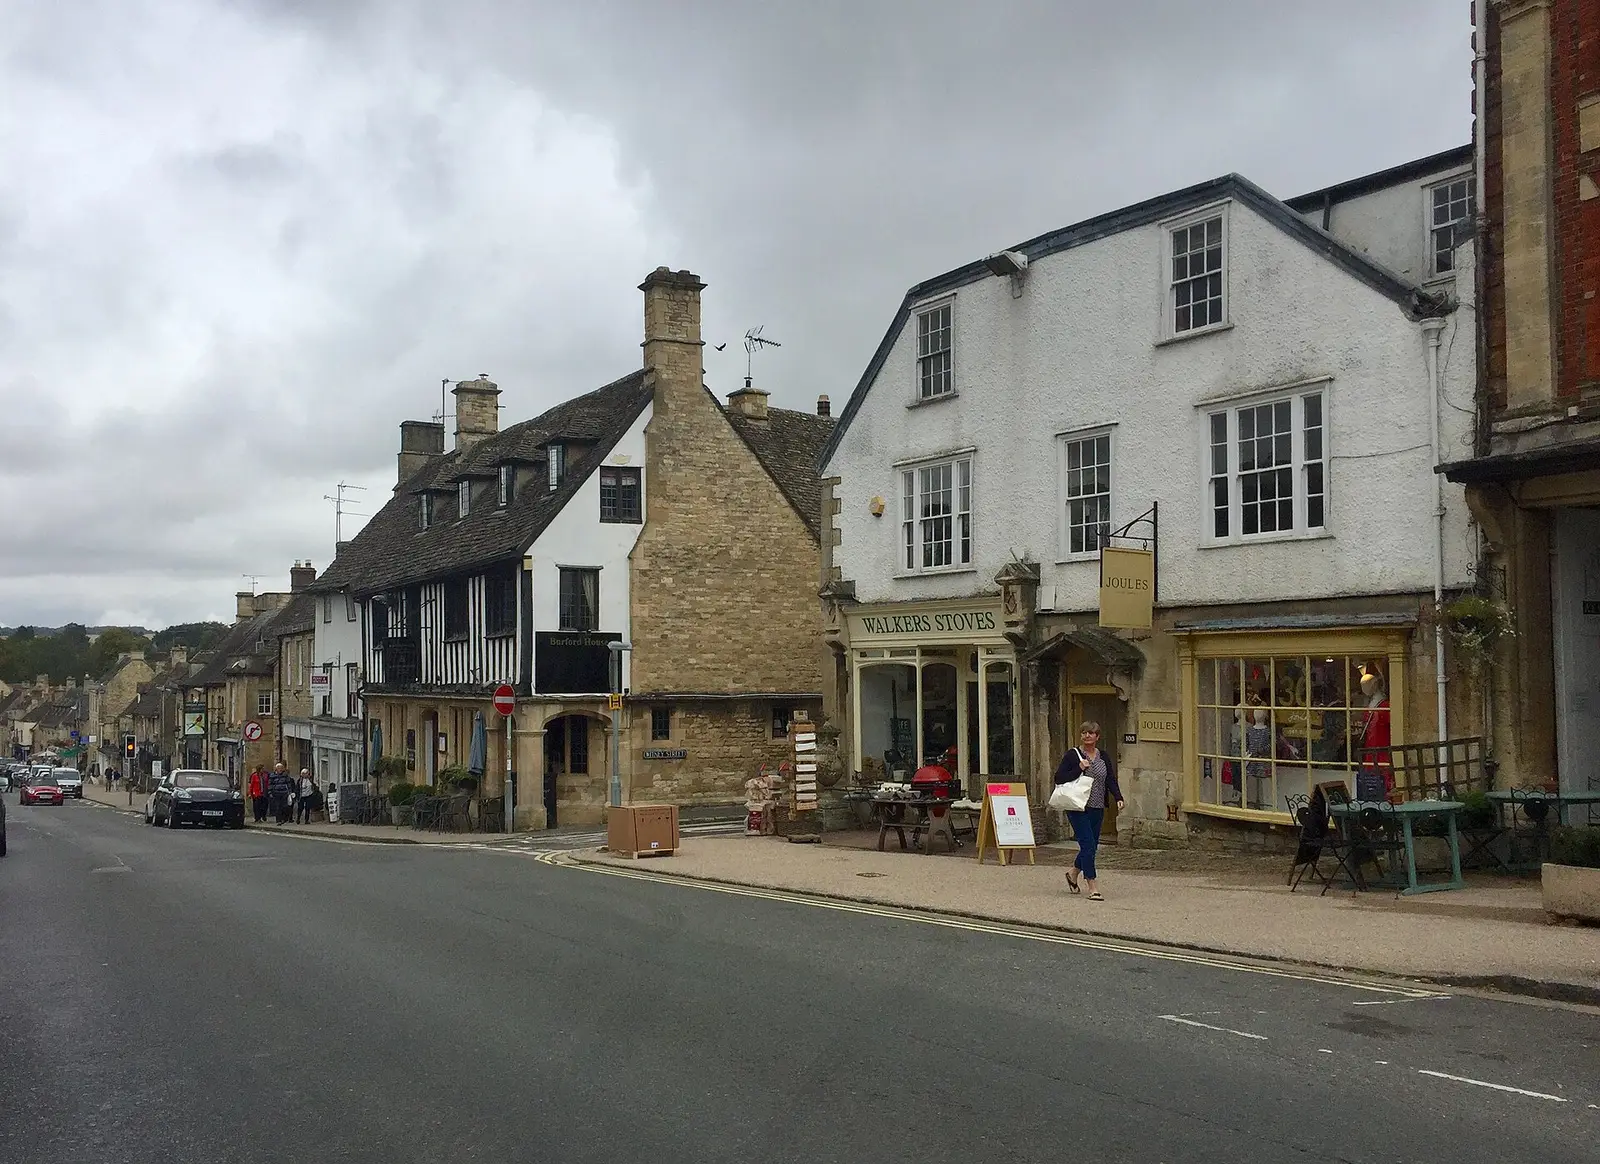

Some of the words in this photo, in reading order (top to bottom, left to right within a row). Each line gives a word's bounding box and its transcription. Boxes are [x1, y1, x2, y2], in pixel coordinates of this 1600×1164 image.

[1106, 577, 1148, 590] JOULES
[862, 614, 932, 633] WALKERS
[934, 612, 995, 631] STOVES
[550, 637, 581, 646] Burford
[1142, 721, 1177, 731] JOULES
